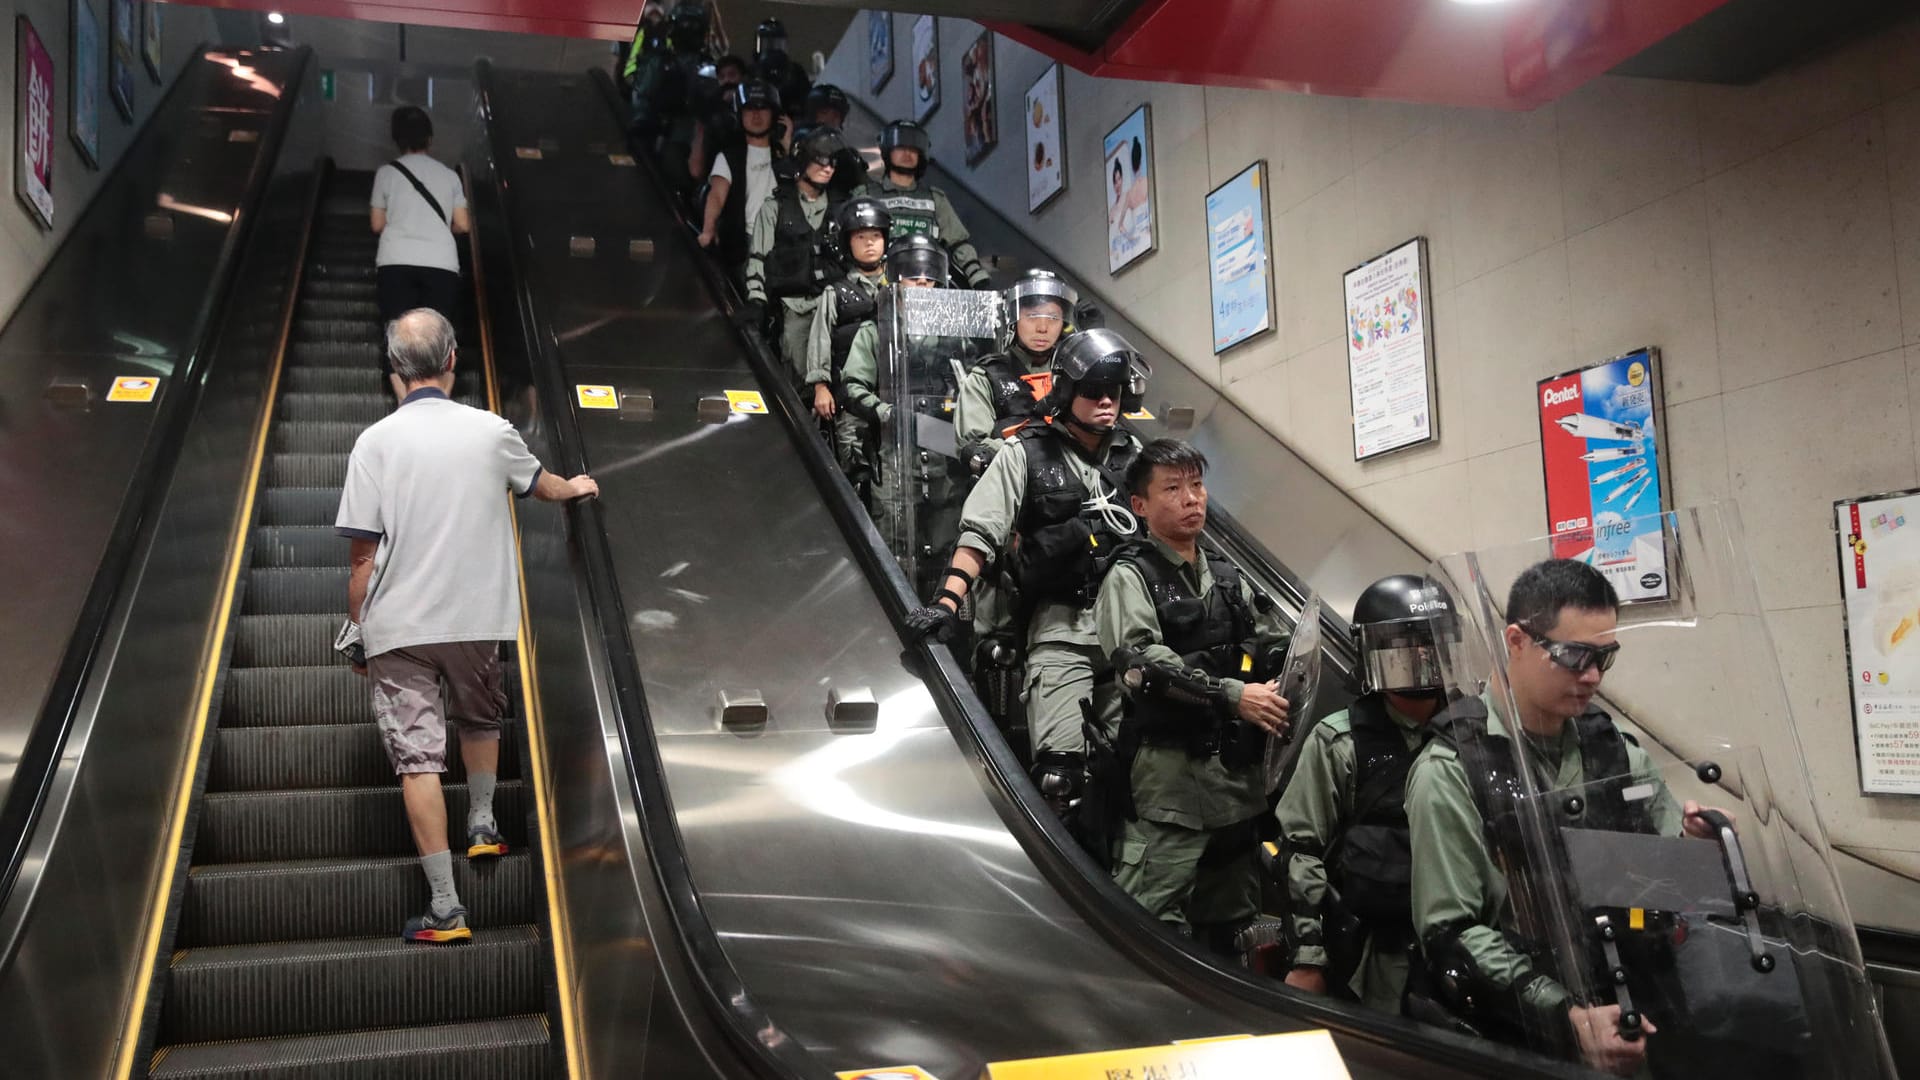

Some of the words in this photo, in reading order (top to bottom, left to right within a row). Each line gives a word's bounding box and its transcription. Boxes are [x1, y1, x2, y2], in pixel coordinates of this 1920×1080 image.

[888, 199, 916, 207] POLICE
[896, 219, 914, 227] FIRST
[1100, 354, 1122, 363] Police
[1543, 384, 1581, 407] Pentel
[1596, 519, 1631, 541] infree
